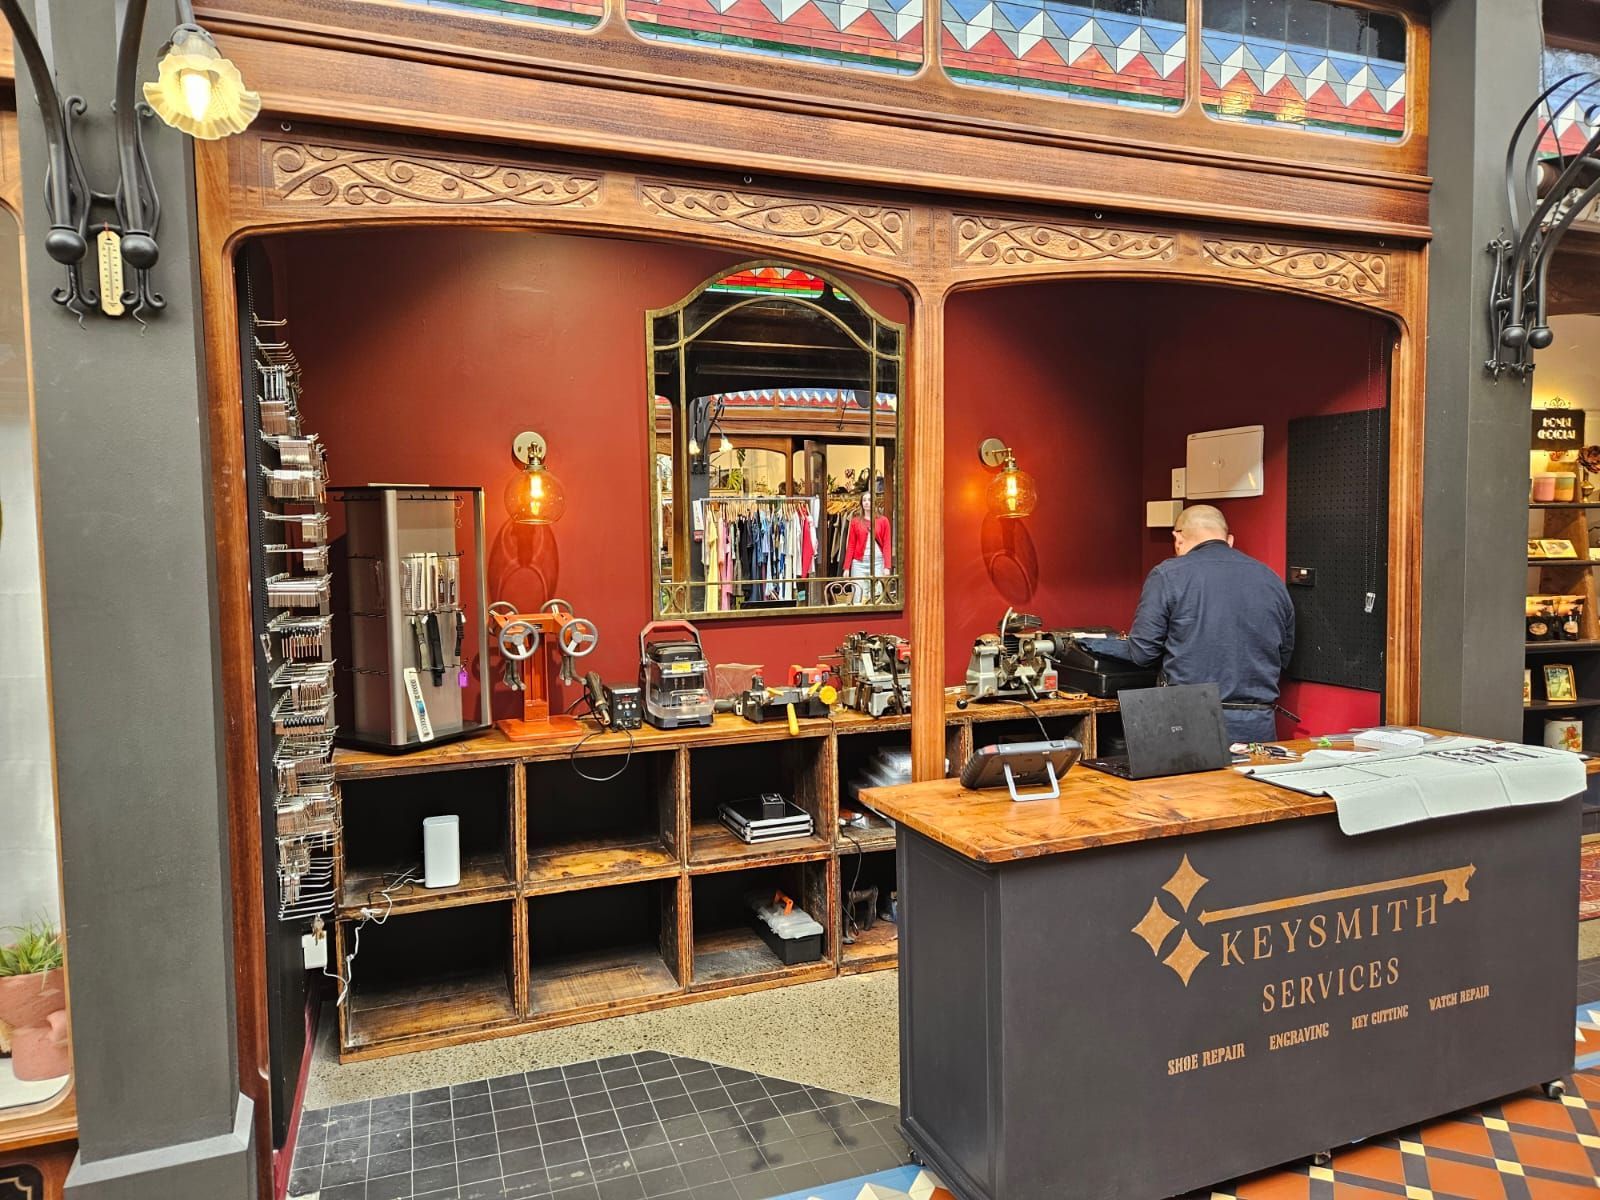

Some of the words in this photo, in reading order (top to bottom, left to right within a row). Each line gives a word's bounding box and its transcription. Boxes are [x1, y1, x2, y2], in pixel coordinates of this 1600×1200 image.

[1220, 893, 1438, 967] KEYSMITH
[1262, 957, 1400, 1013] SERVICES
[1429, 992, 1458, 1012] WATCH
[1459, 984, 1490, 1004] REPAIR
[1351, 1013, 1369, 1030] KEY
[1371, 1004, 1409, 1025] CUTTING
[1269, 1022, 1330, 1051] ENGRAVING
[1167, 1053, 1199, 1076] SHOE
[1202, 1042, 1246, 1067] REPAIR
